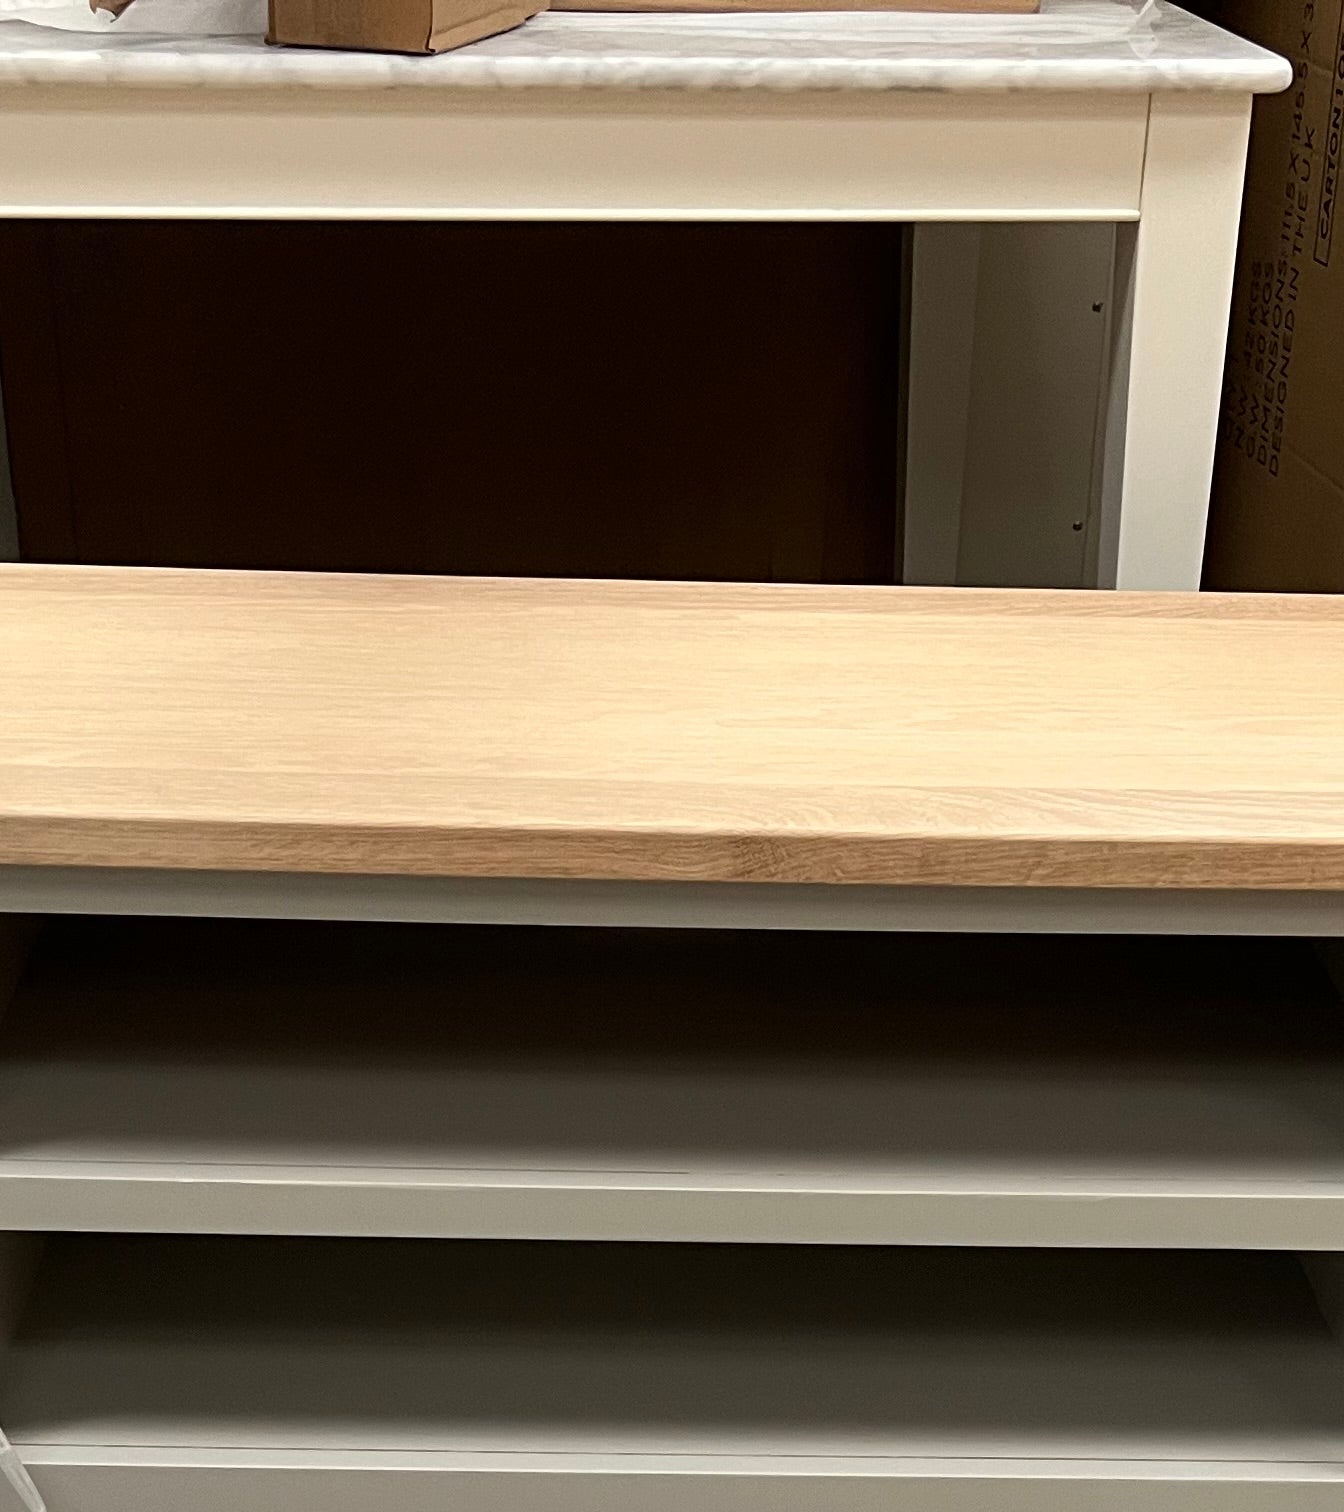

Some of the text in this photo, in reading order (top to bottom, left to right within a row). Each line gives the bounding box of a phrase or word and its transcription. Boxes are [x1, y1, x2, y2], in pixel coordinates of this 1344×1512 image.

[1288, 150, 1300, 175] X
[1300, 30, 1312, 54] X
[1320, 106, 1342, 240] CARTON
[1335, 88, 1344, 98] 1
[1292, 191, 1308, 256] THE
[1248, 261, 1262, 326] KGS
[1259, 262, 1274, 327] KGS
[1288, 266, 1300, 302] IN
[1254, 334, 1266, 375] 50
[1269, 309, 1295, 477] DESIGNED
